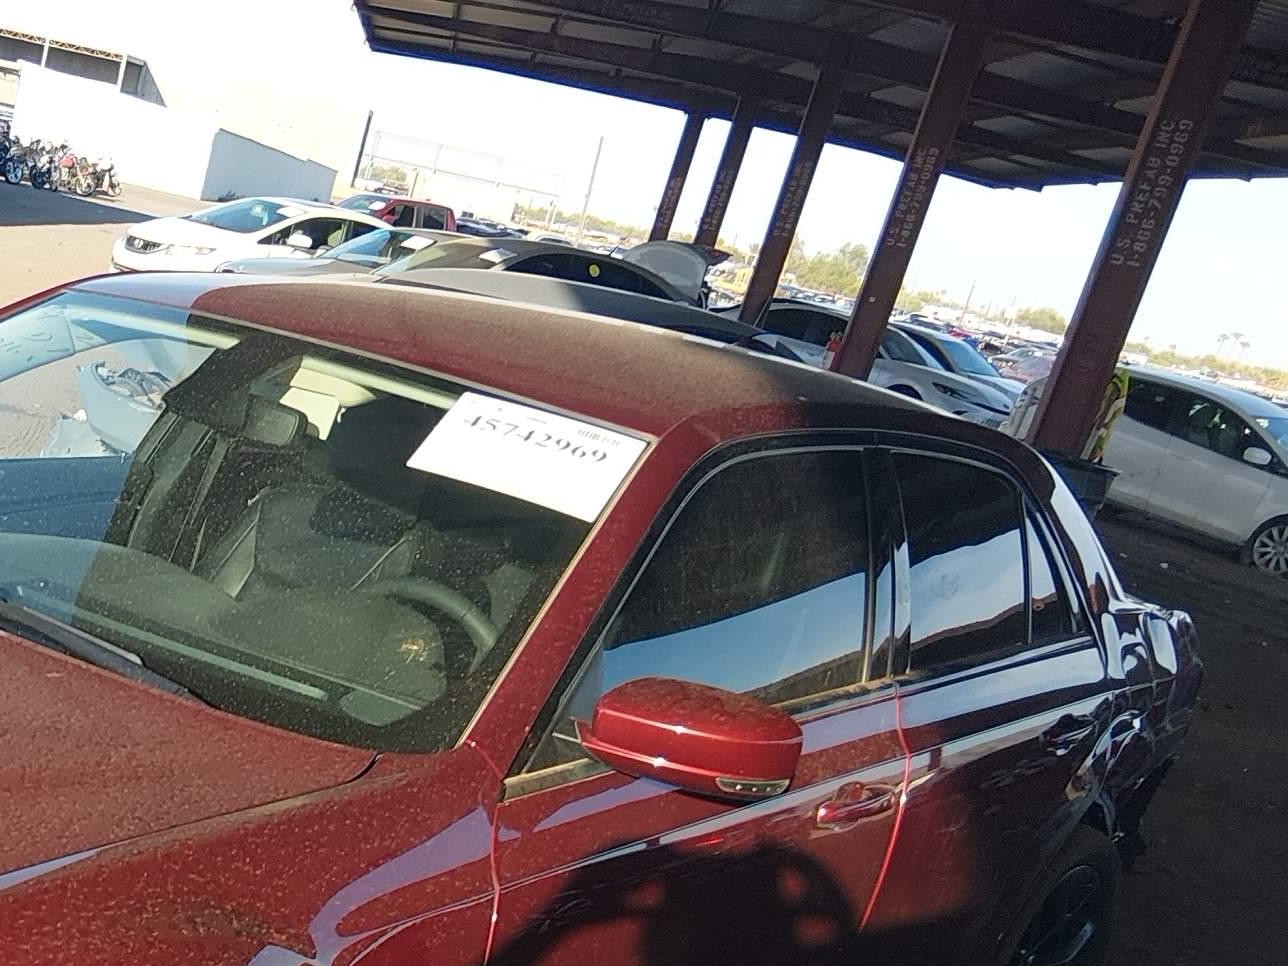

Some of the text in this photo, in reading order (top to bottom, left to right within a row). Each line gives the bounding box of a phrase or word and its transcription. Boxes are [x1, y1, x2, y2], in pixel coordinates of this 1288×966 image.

[1126, 156, 1161, 224] PREFAB
[1126, 119, 1194, 267] 1-866-799-0969
[464, 416, 607, 463] 45742969
